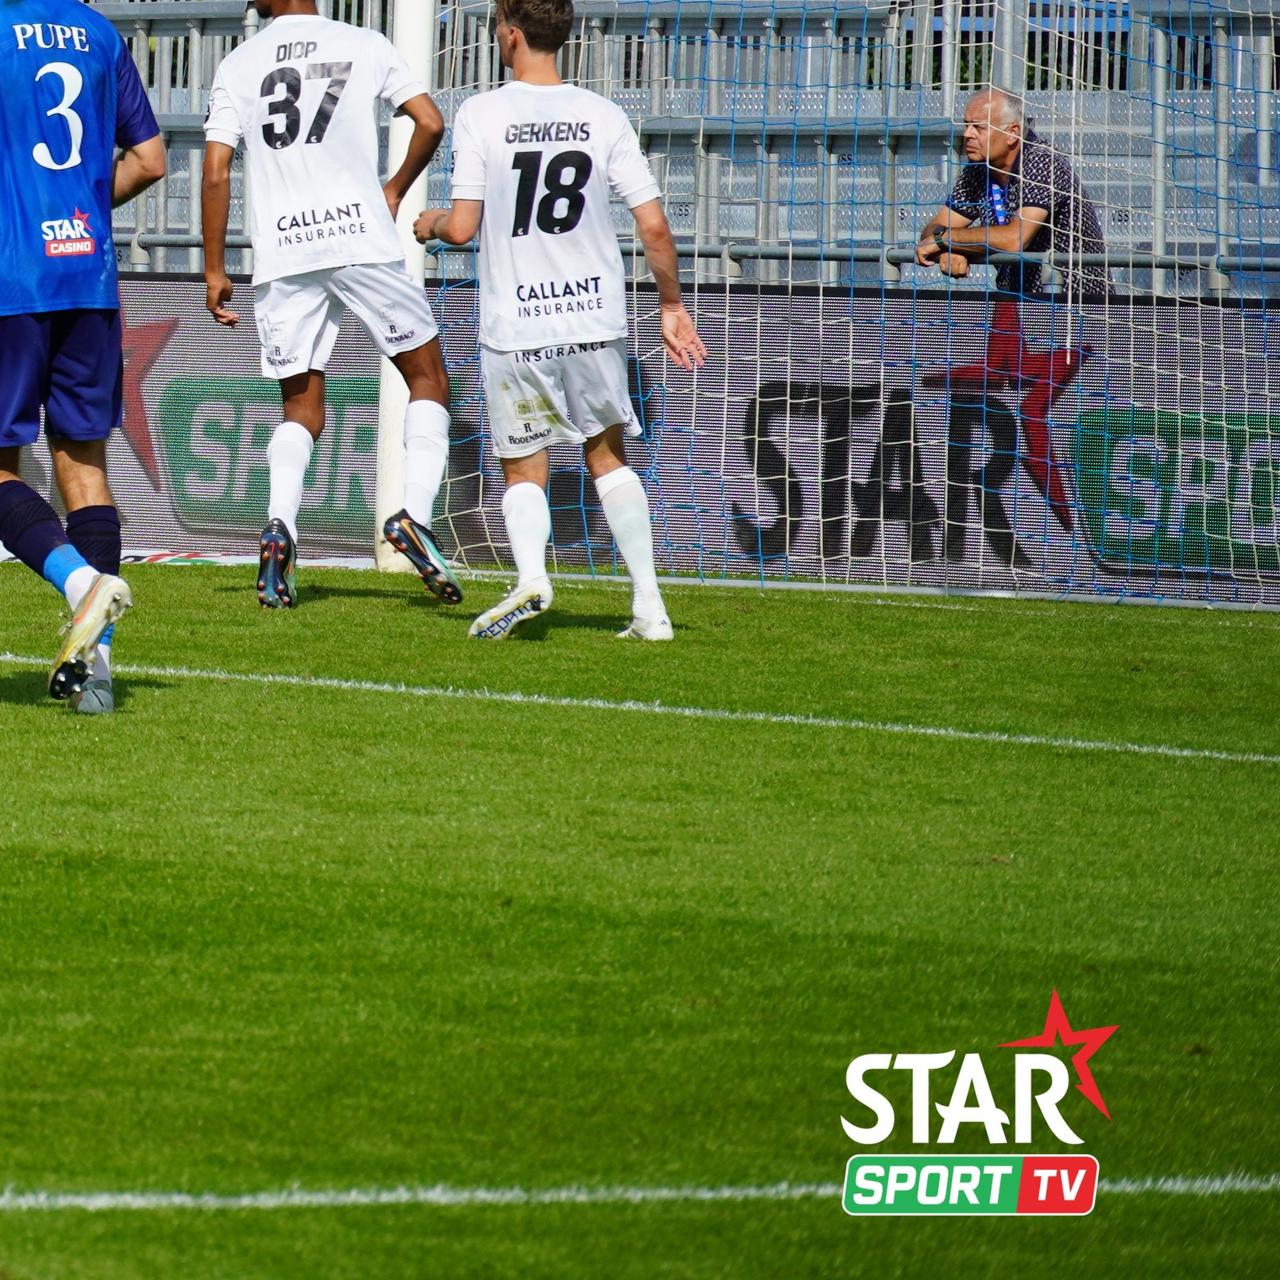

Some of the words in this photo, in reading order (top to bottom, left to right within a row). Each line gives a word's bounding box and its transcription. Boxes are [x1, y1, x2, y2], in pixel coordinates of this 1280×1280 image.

[12, 23, 90, 52] PUPE
[275, 40, 318, 63] DIOP
[32, 61, 85, 171] 3
[260, 61, 353, 151] 37
[505, 121, 592, 145] GERKENS
[511, 150, 593, 238] 18
[40, 219, 90, 240] STAR
[276, 202, 363, 232] CALLANT
[278, 221, 367, 247] INSURANCE
[49, 242, 92, 255] CASINO
[516, 276, 602, 302] CALLANT
[517, 297, 604, 319] INSURANCE
[515, 342, 607, 363] INSURANCE
[508, 427, 553, 446] RODENBACH
[732, 380, 1033, 566] STAR
